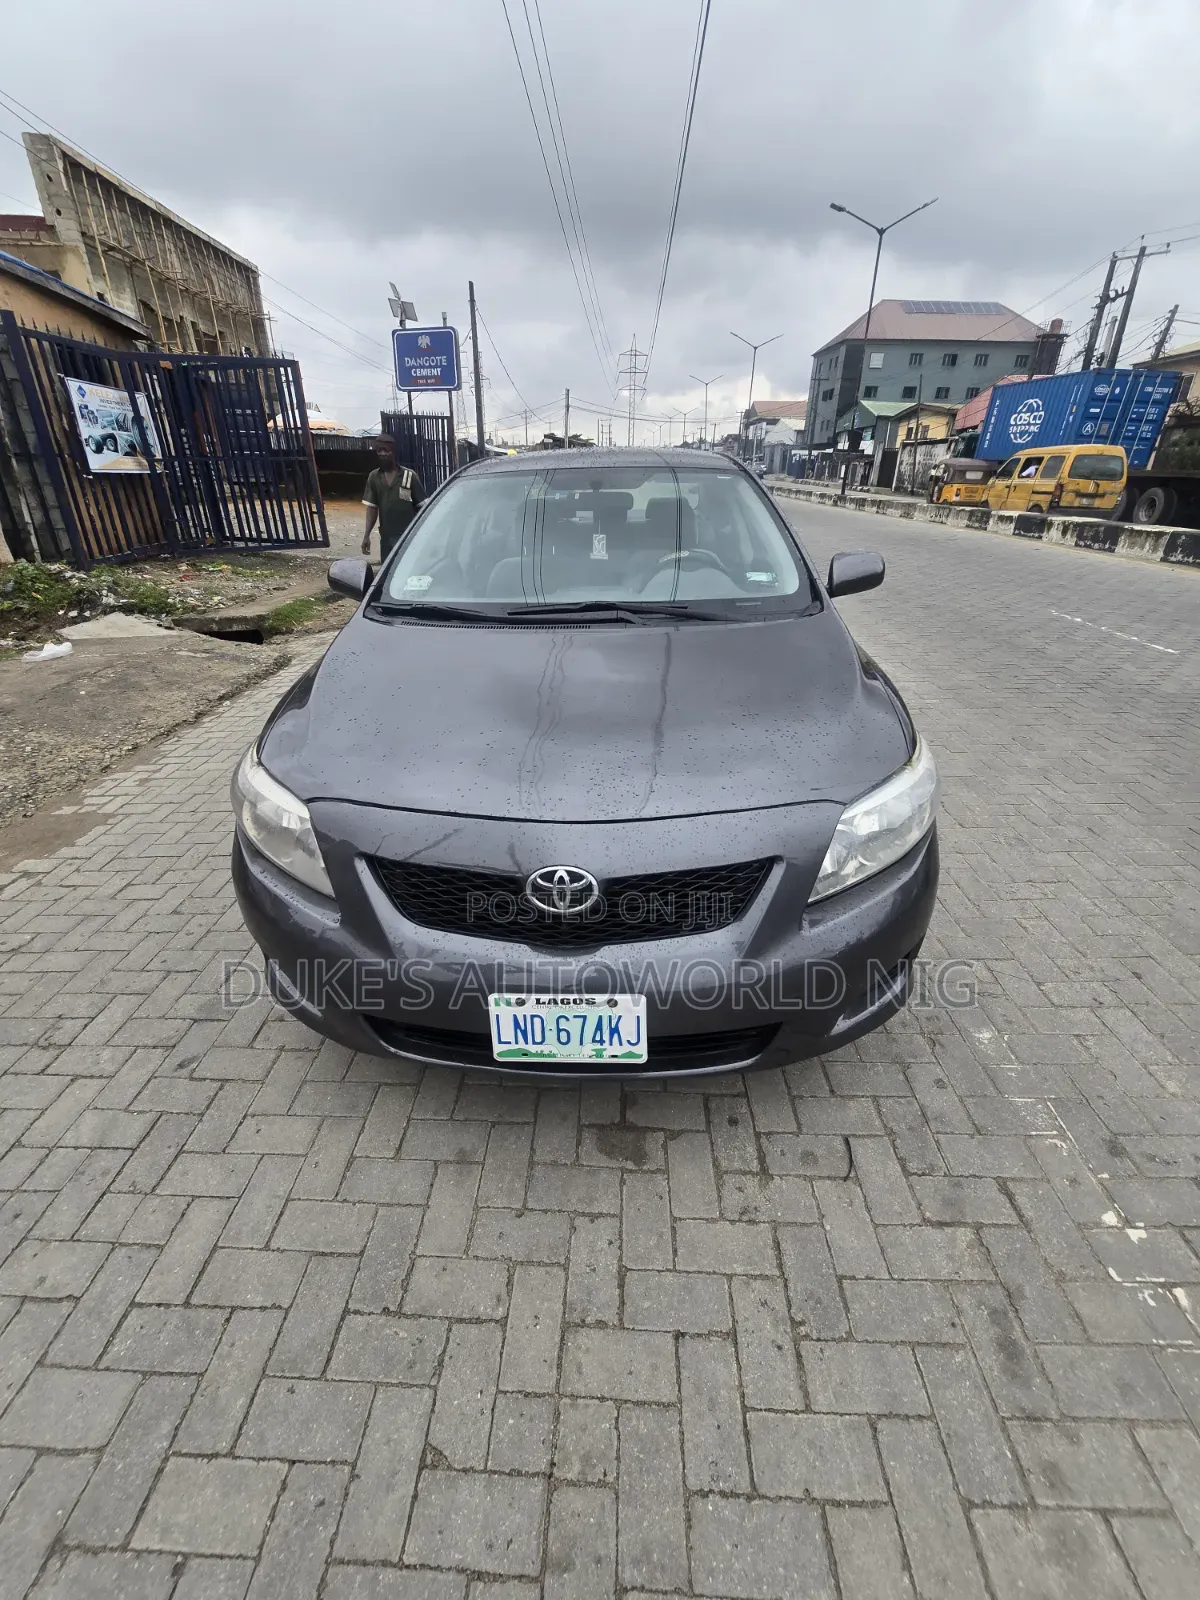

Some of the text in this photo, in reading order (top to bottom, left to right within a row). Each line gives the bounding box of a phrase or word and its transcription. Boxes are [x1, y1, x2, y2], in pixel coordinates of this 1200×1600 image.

[405, 356, 447, 367] DANGOTE
[411, 367, 442, 376] CEMENT
[1010, 411, 1045, 425] COSCO
[1009, 424, 1041, 433] SHIPPING
[535, 997, 597, 1006] LAGOS
